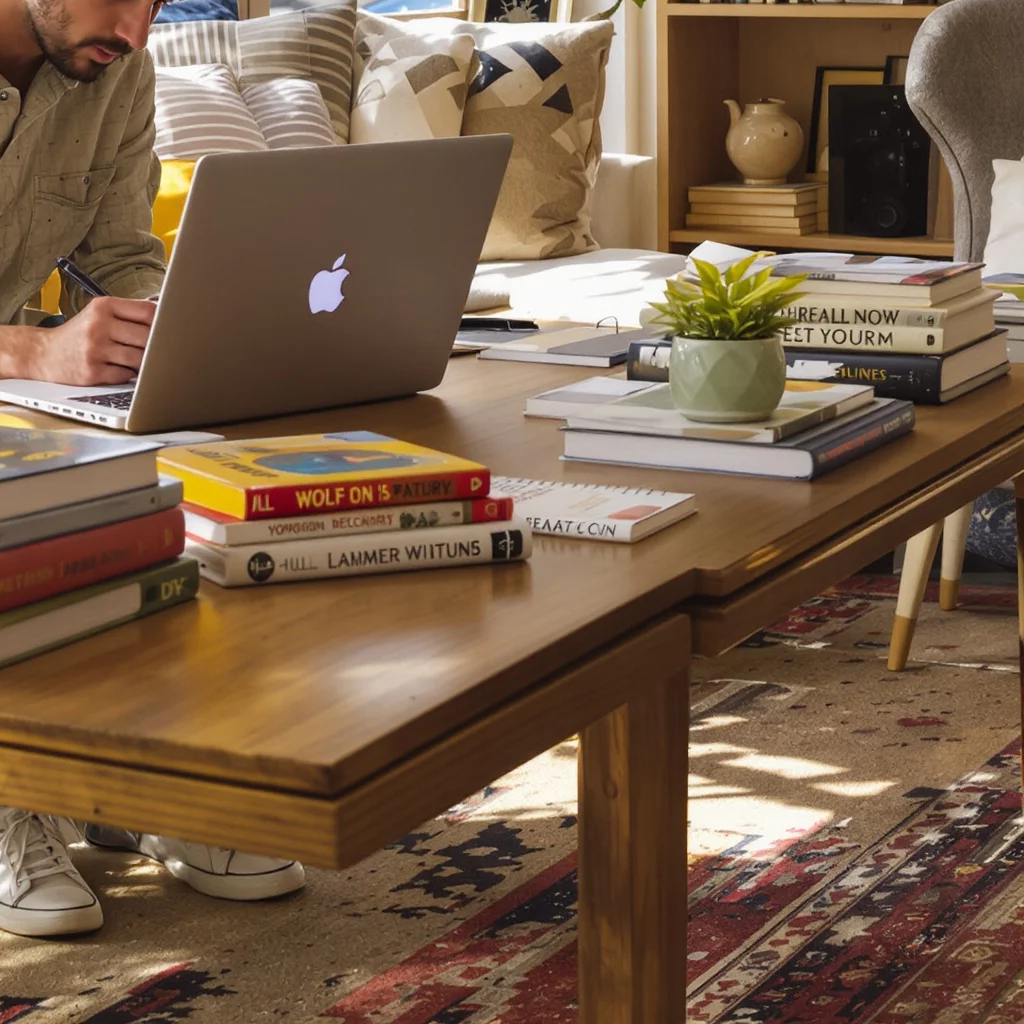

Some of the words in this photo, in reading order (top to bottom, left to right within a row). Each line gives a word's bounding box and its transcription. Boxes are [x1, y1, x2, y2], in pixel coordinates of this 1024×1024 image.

[854, 309, 900, 325] NOW
[295, 487, 345, 509] WOLF
[350, 484, 373, 504] ON
